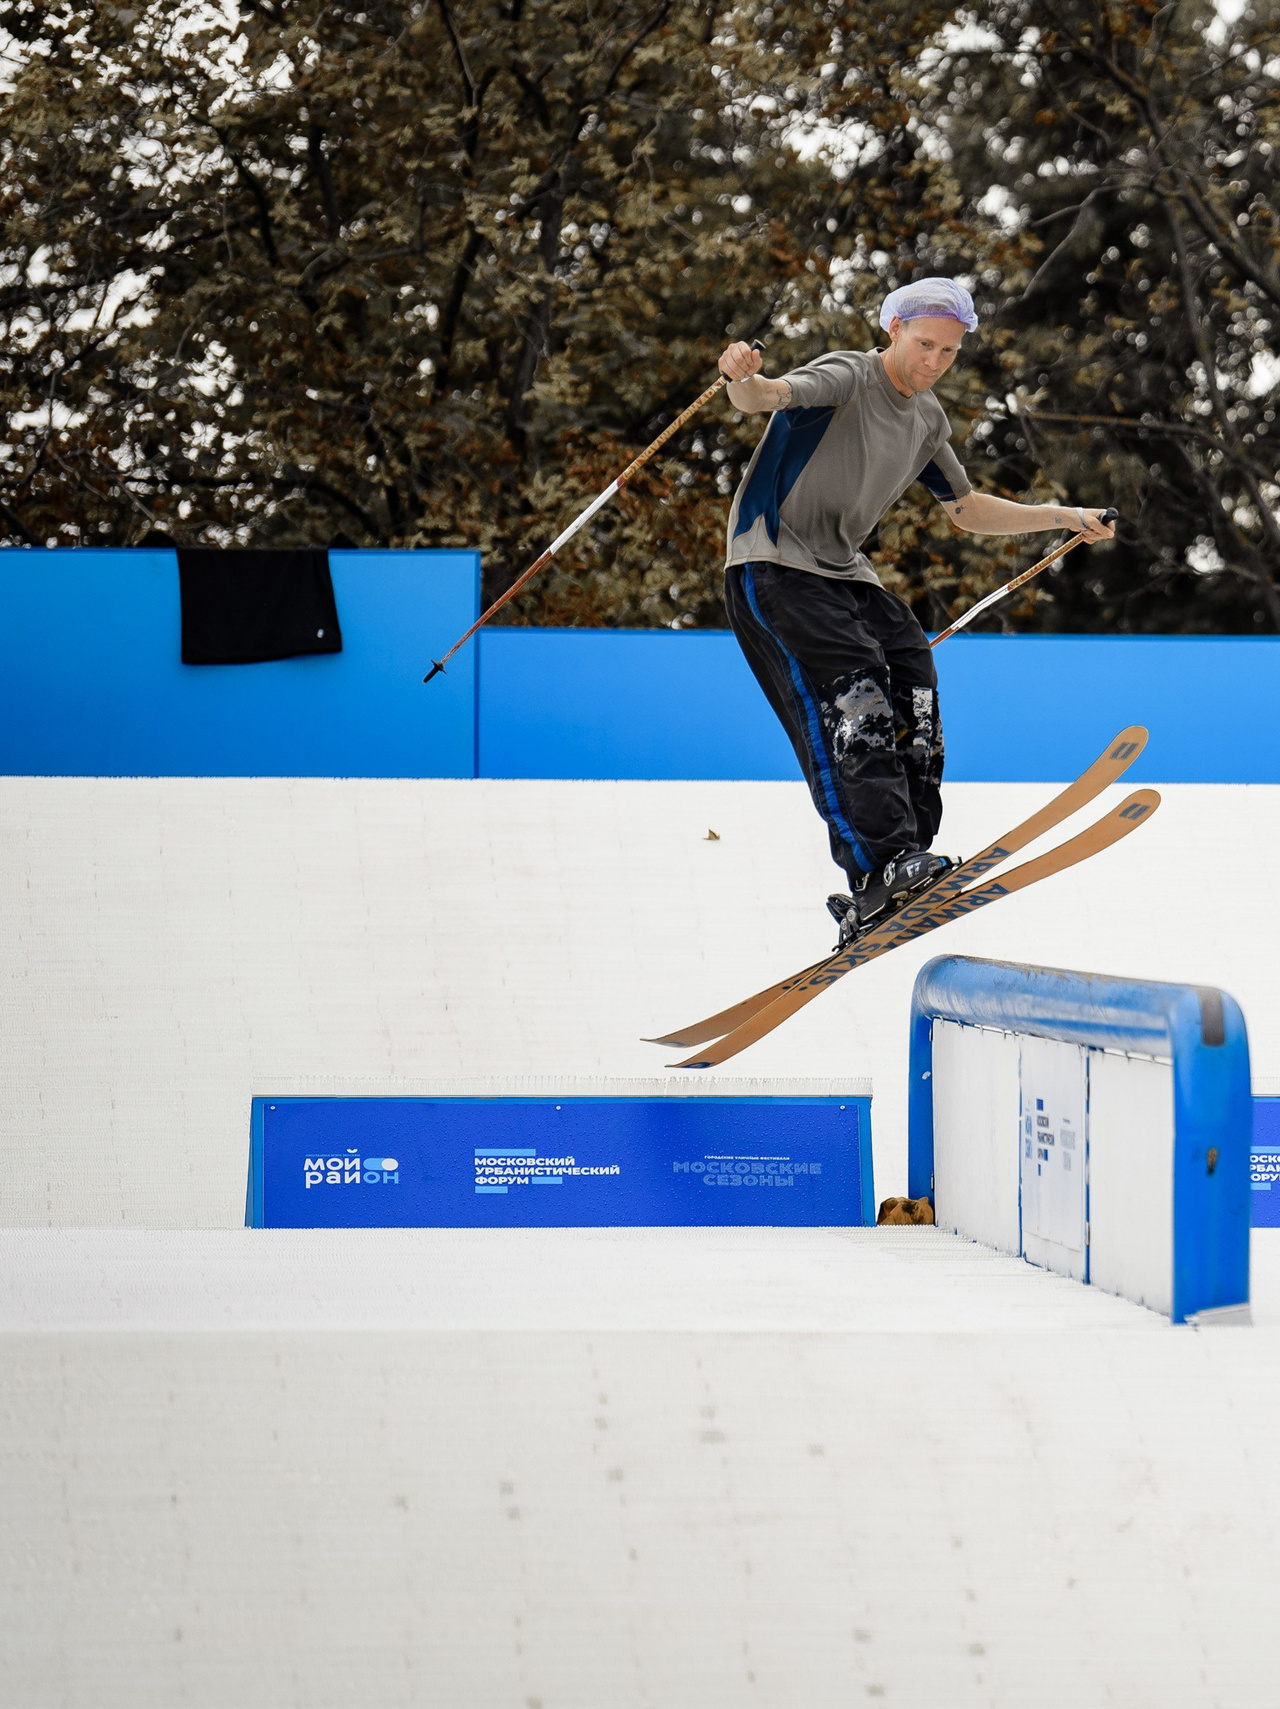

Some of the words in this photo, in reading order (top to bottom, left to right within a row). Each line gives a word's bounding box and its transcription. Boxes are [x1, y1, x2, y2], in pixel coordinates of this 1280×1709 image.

[875, 846, 1011, 935] ARMADA
[474, 1155, 575, 1166] МОСКОВСКИЙ
[474, 1165, 620, 1175] УРБАНИСТИЧЕСКИЙ
[672, 1161, 822, 1175] МОСКОВСКИЕ
[474, 1176, 529, 1185] ФОРУМ
[702, 1174, 794, 1187] СЕЗОНЫ
